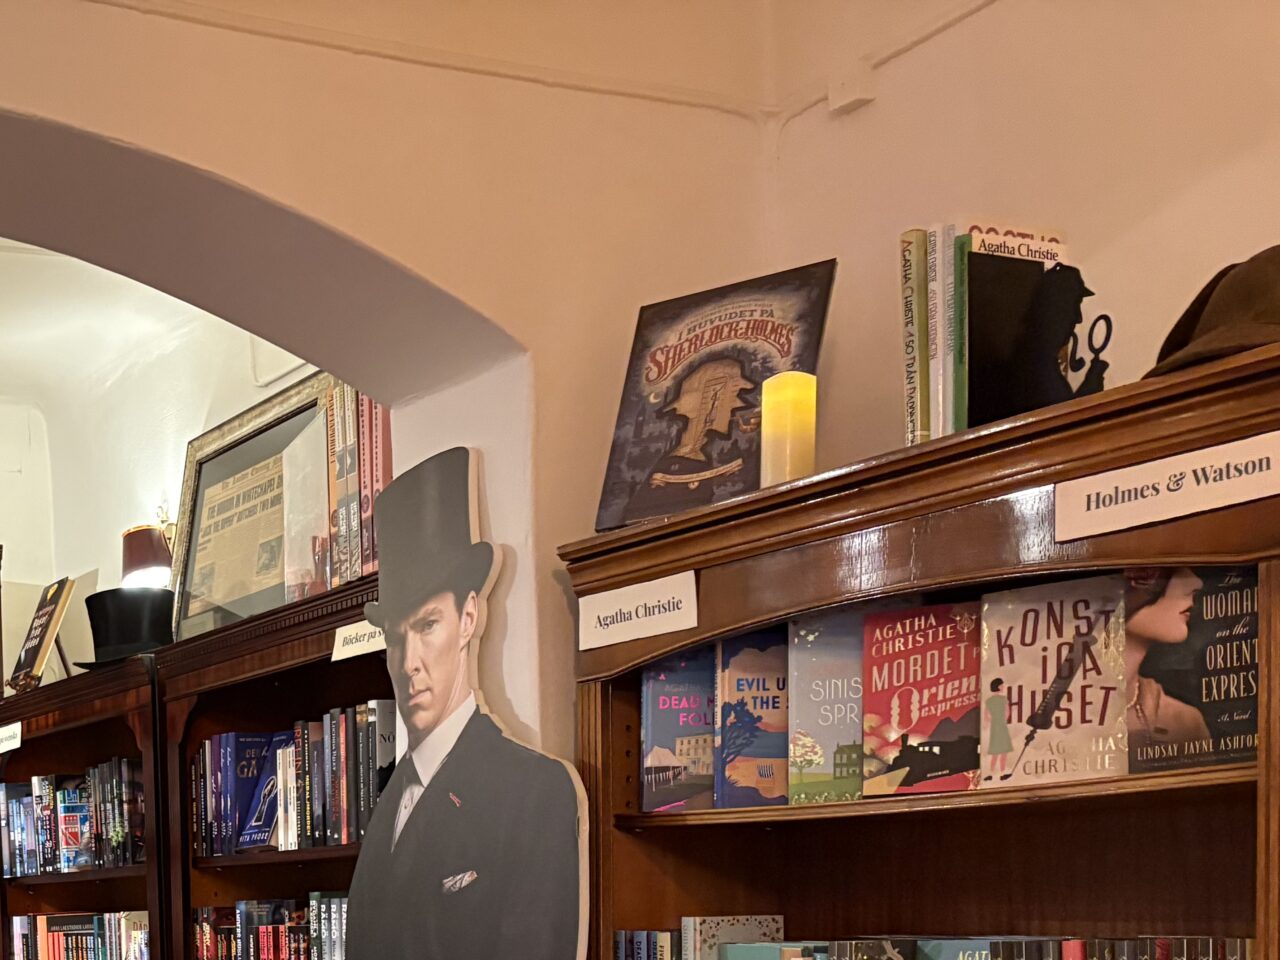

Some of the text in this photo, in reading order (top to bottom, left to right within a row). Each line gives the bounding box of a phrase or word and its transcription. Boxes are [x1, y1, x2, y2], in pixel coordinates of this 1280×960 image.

[978, 238, 1059, 261] Agatha Christie
[687, 306, 775, 334] HUVUDET PÅ
[645, 320, 798, 384] SHERLOCK HOLMES
[1084, 455, 1272, 513] Holmes & Watson
[594, 596, 683, 630] Agatha Christie
[343, 628, 378, 648] Böcker på
[872, 613, 937, 642] AGATHA
[1216, 621, 1249, 638] on the
[871, 624, 956, 658] CHRISTIE
[871, 643, 969, 693] MORDET
[736, 678, 770, 692] EVIL
[659, 696, 701, 711] DEAD
[750, 696, 781, 710] THE
[1137, 739, 1215, 761] LINDSAY JAYNE
